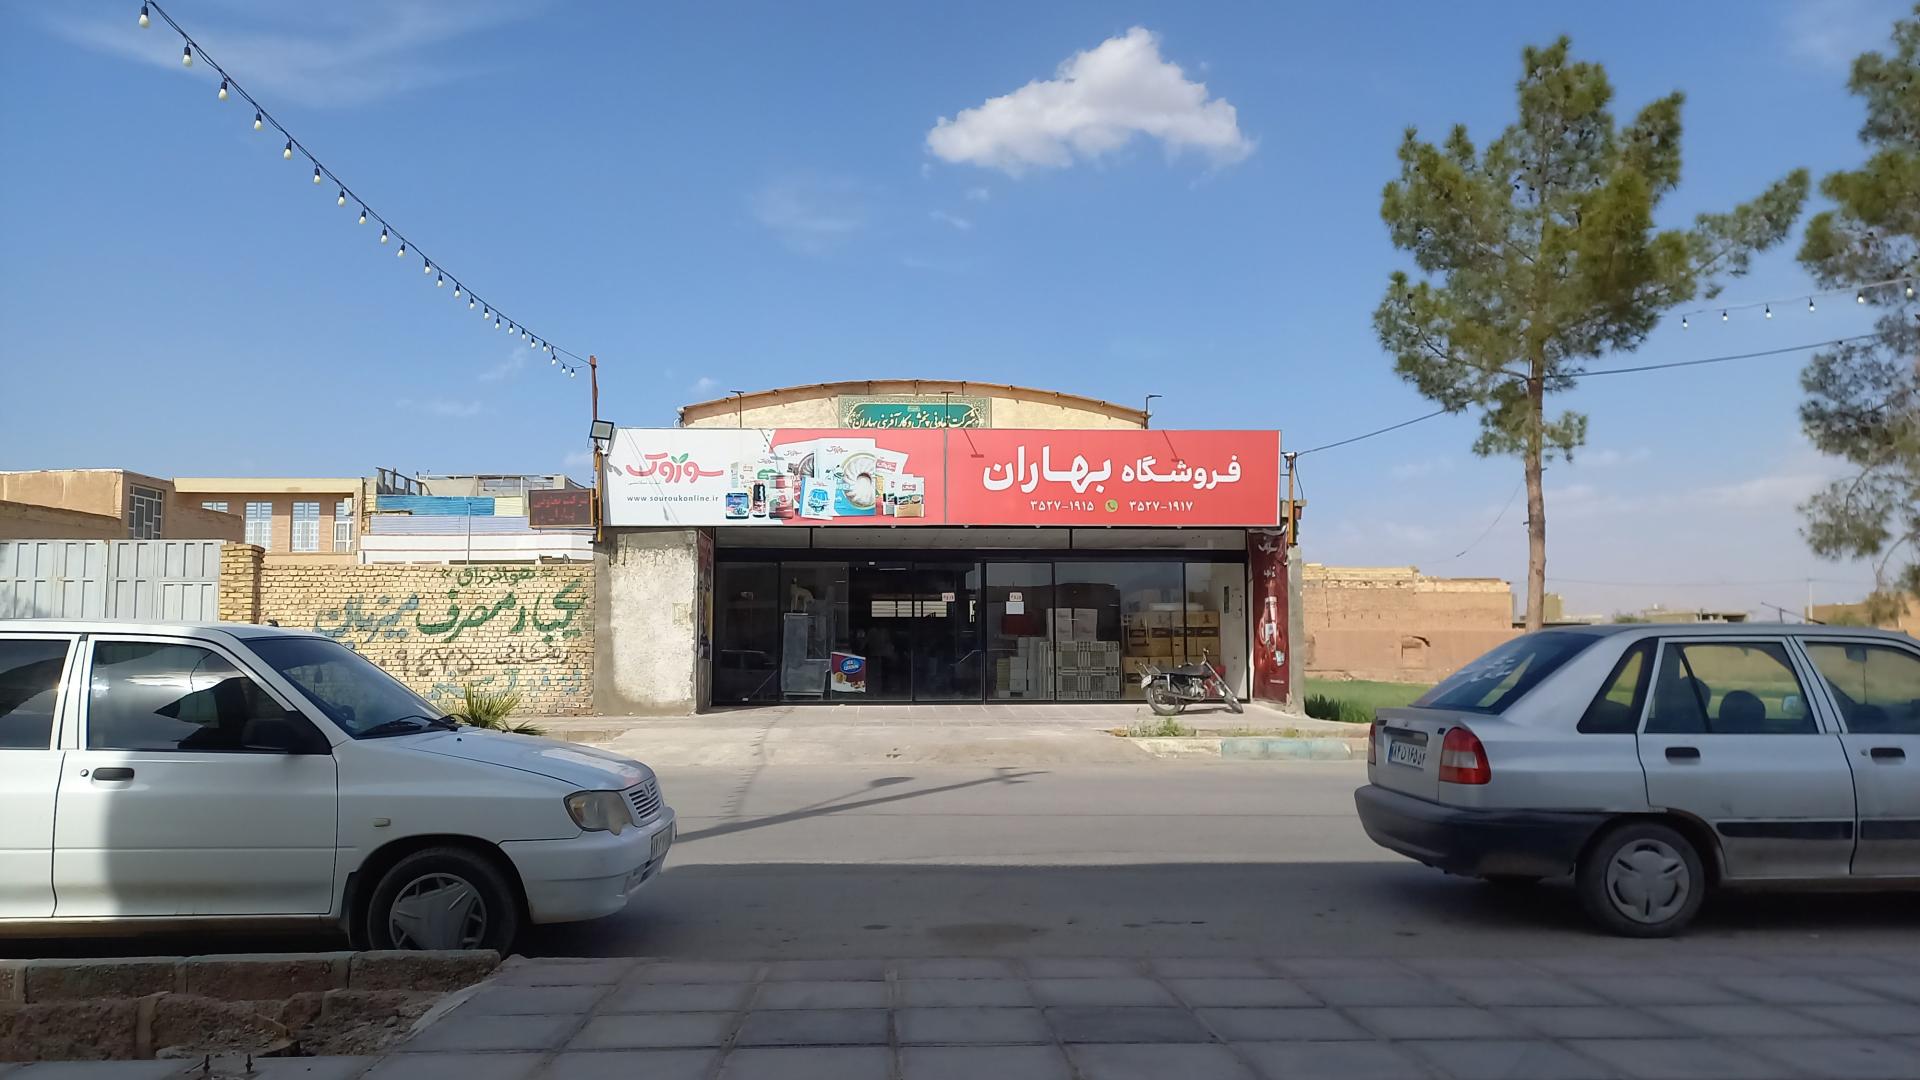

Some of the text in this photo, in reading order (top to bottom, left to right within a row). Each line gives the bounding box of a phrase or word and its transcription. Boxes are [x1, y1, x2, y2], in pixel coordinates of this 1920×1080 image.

[982, 445, 1242, 494] فروشگاه بهاران
[1030, 499, 1095, 512] ۳۵۲۷-۱۹۱۵
[1129, 499, 1194, 512] ۳۵۲۷-۱۹۱۷
[417, 589, 517, 643] مصرف
